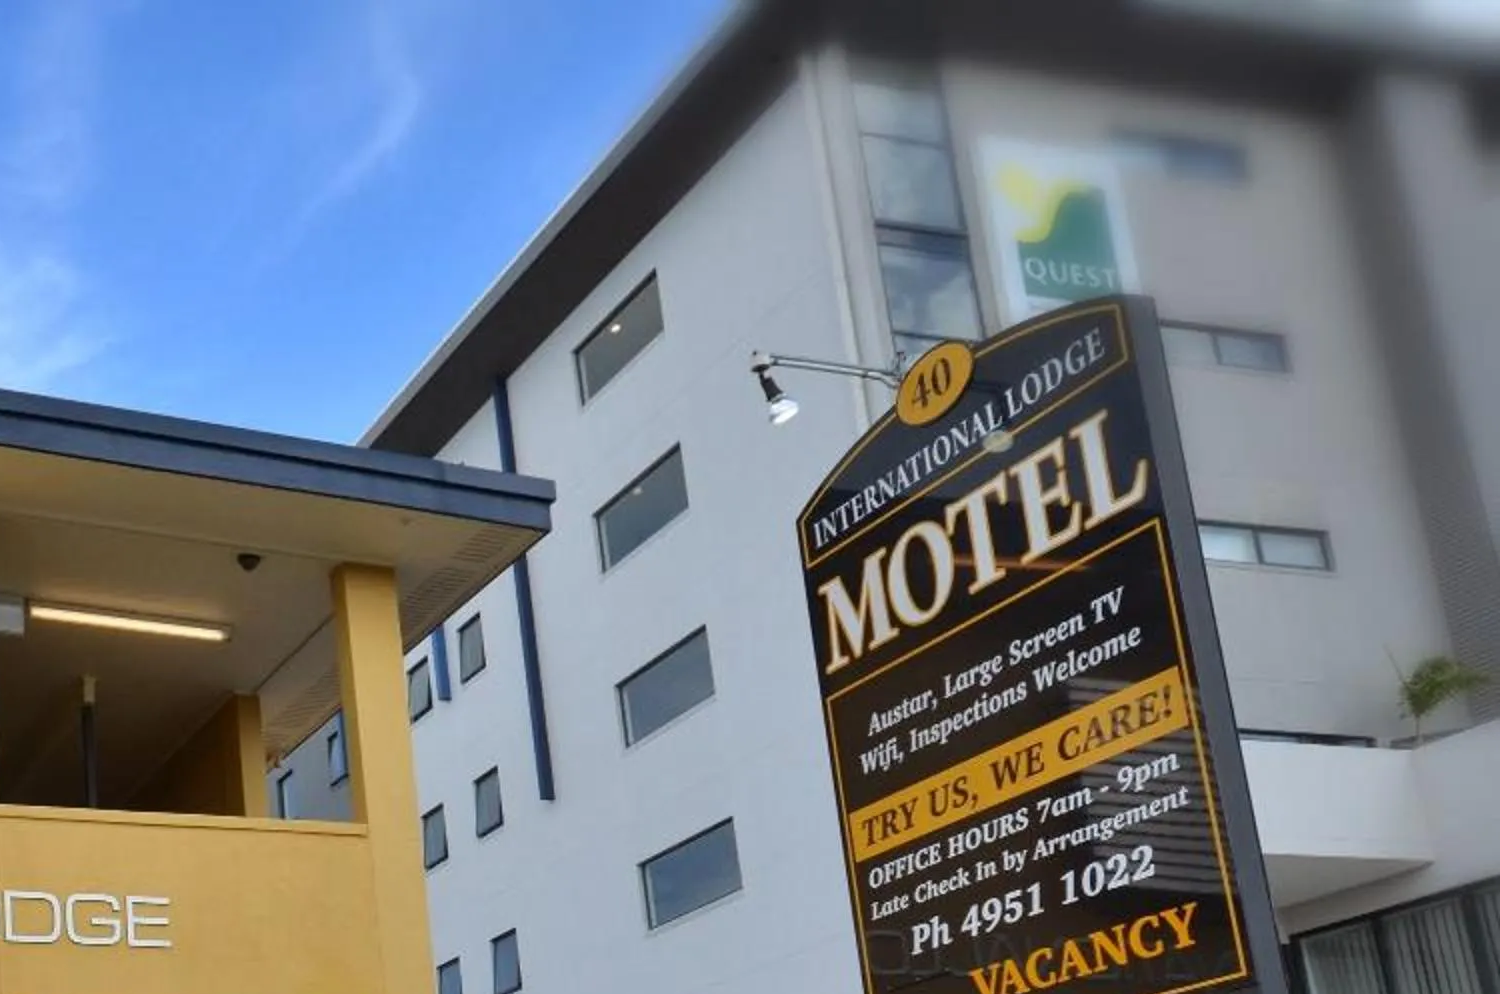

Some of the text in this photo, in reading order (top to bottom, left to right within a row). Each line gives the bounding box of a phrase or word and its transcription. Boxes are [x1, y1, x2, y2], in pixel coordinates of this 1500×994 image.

[1025, 257, 1117, 289] QUEST
[812, 327, 1106, 549] INTERNATIONAL LODGE
[911, 357, 951, 410] 40
[818, 409, 1149, 674] MOTEL
[858, 625, 1143, 776] Wifi, Inspections Welcome
[867, 585, 1125, 737] Austar, Large Screen TV
[861, 684, 1174, 849] TRY US, WE CARE!
[867, 844, 942, 890] OFFICE
[947, 806, 1030, 860] HOURS
[1037, 787, 1093, 825] 7am
[1116, 752, 1181, 794] 9pm
[870, 786, 1190, 922] Late Check In by Arrangement
[911, 844, 1157, 957] Ph 4951 1022
